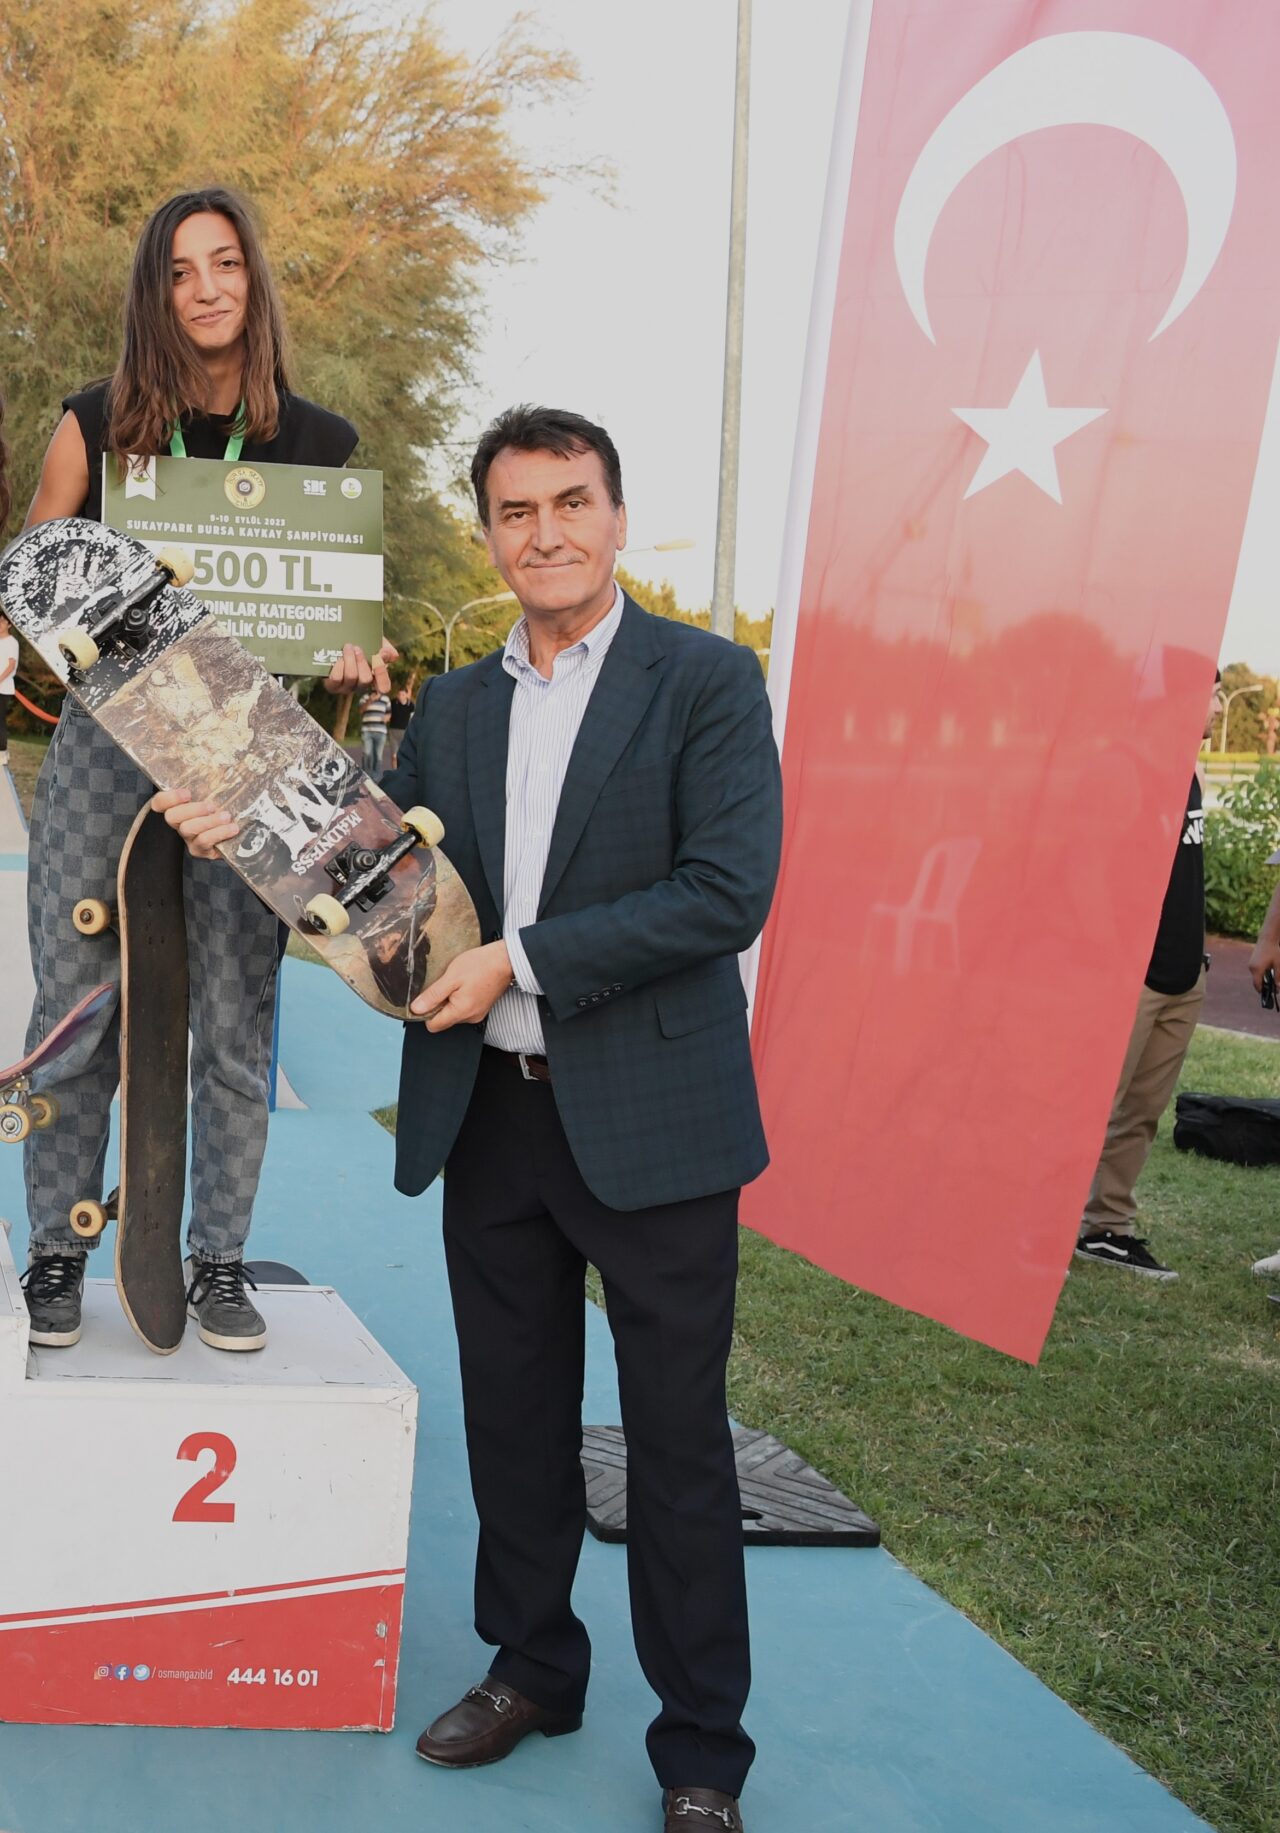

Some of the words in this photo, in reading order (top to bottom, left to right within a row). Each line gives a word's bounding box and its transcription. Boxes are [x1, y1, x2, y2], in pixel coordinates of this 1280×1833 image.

[127, 520, 192, 533] SUKAYPARK
[198, 525, 234, 536] BURSA
[239, 527, 282, 538] KAYKAY
[287, 531, 363, 544] ŞAMPİYONASI
[193, 550, 267, 588] 500
[279, 555, 332, 592] TL.
[204, 600, 256, 617] DINLAR
[260, 603, 342, 622] KATEGORİSİ
[257, 621, 305, 640] ÖDÜLÜ
[291, 809, 363, 877] MADNESS
[172, 1431, 237, 1523] 2
[227, 1667, 267, 1684] 444
[273, 1668, 294, 1686] 16
[297, 1669, 319, 1687] 01
